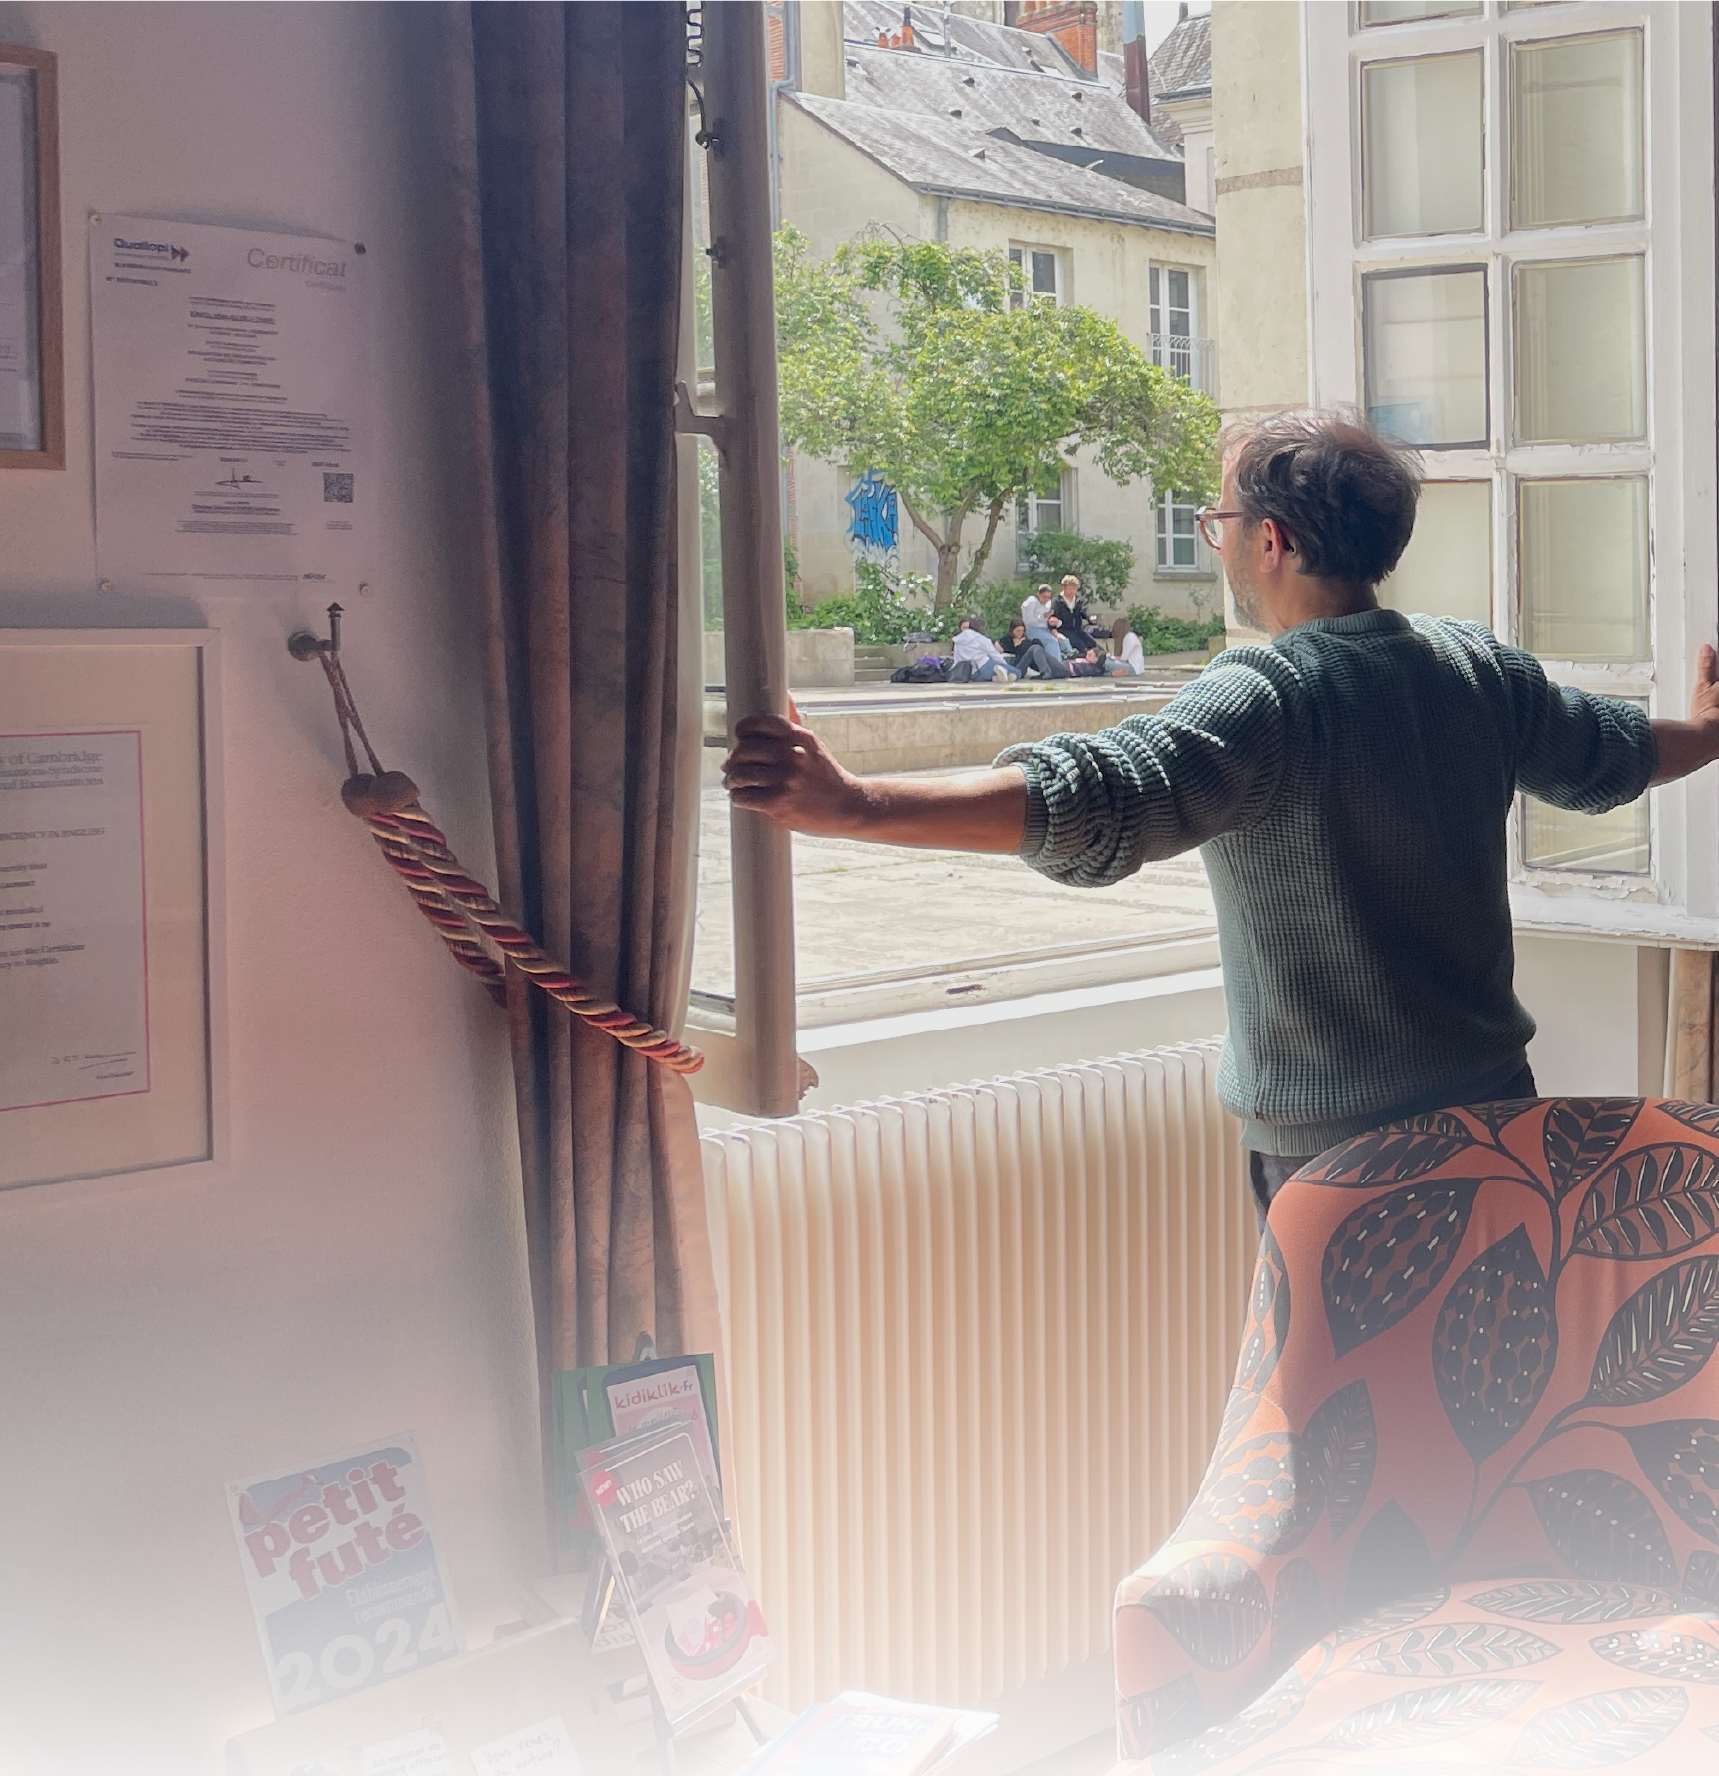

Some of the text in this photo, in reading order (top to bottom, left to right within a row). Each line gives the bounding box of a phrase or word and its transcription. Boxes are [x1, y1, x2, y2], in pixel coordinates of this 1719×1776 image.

[247, 247, 347, 278] Certificat
[10, 750, 104, 766] of Cambridge
[616, 1460, 684, 1507] WHO SAW
[619, 1504, 652, 1533] THE
[650, 1480, 695, 1518] BEAR?
[244, 1460, 407, 1578] petit
[289, 1502, 425, 1600] futé
[276, 1604, 449, 1707] 2024
